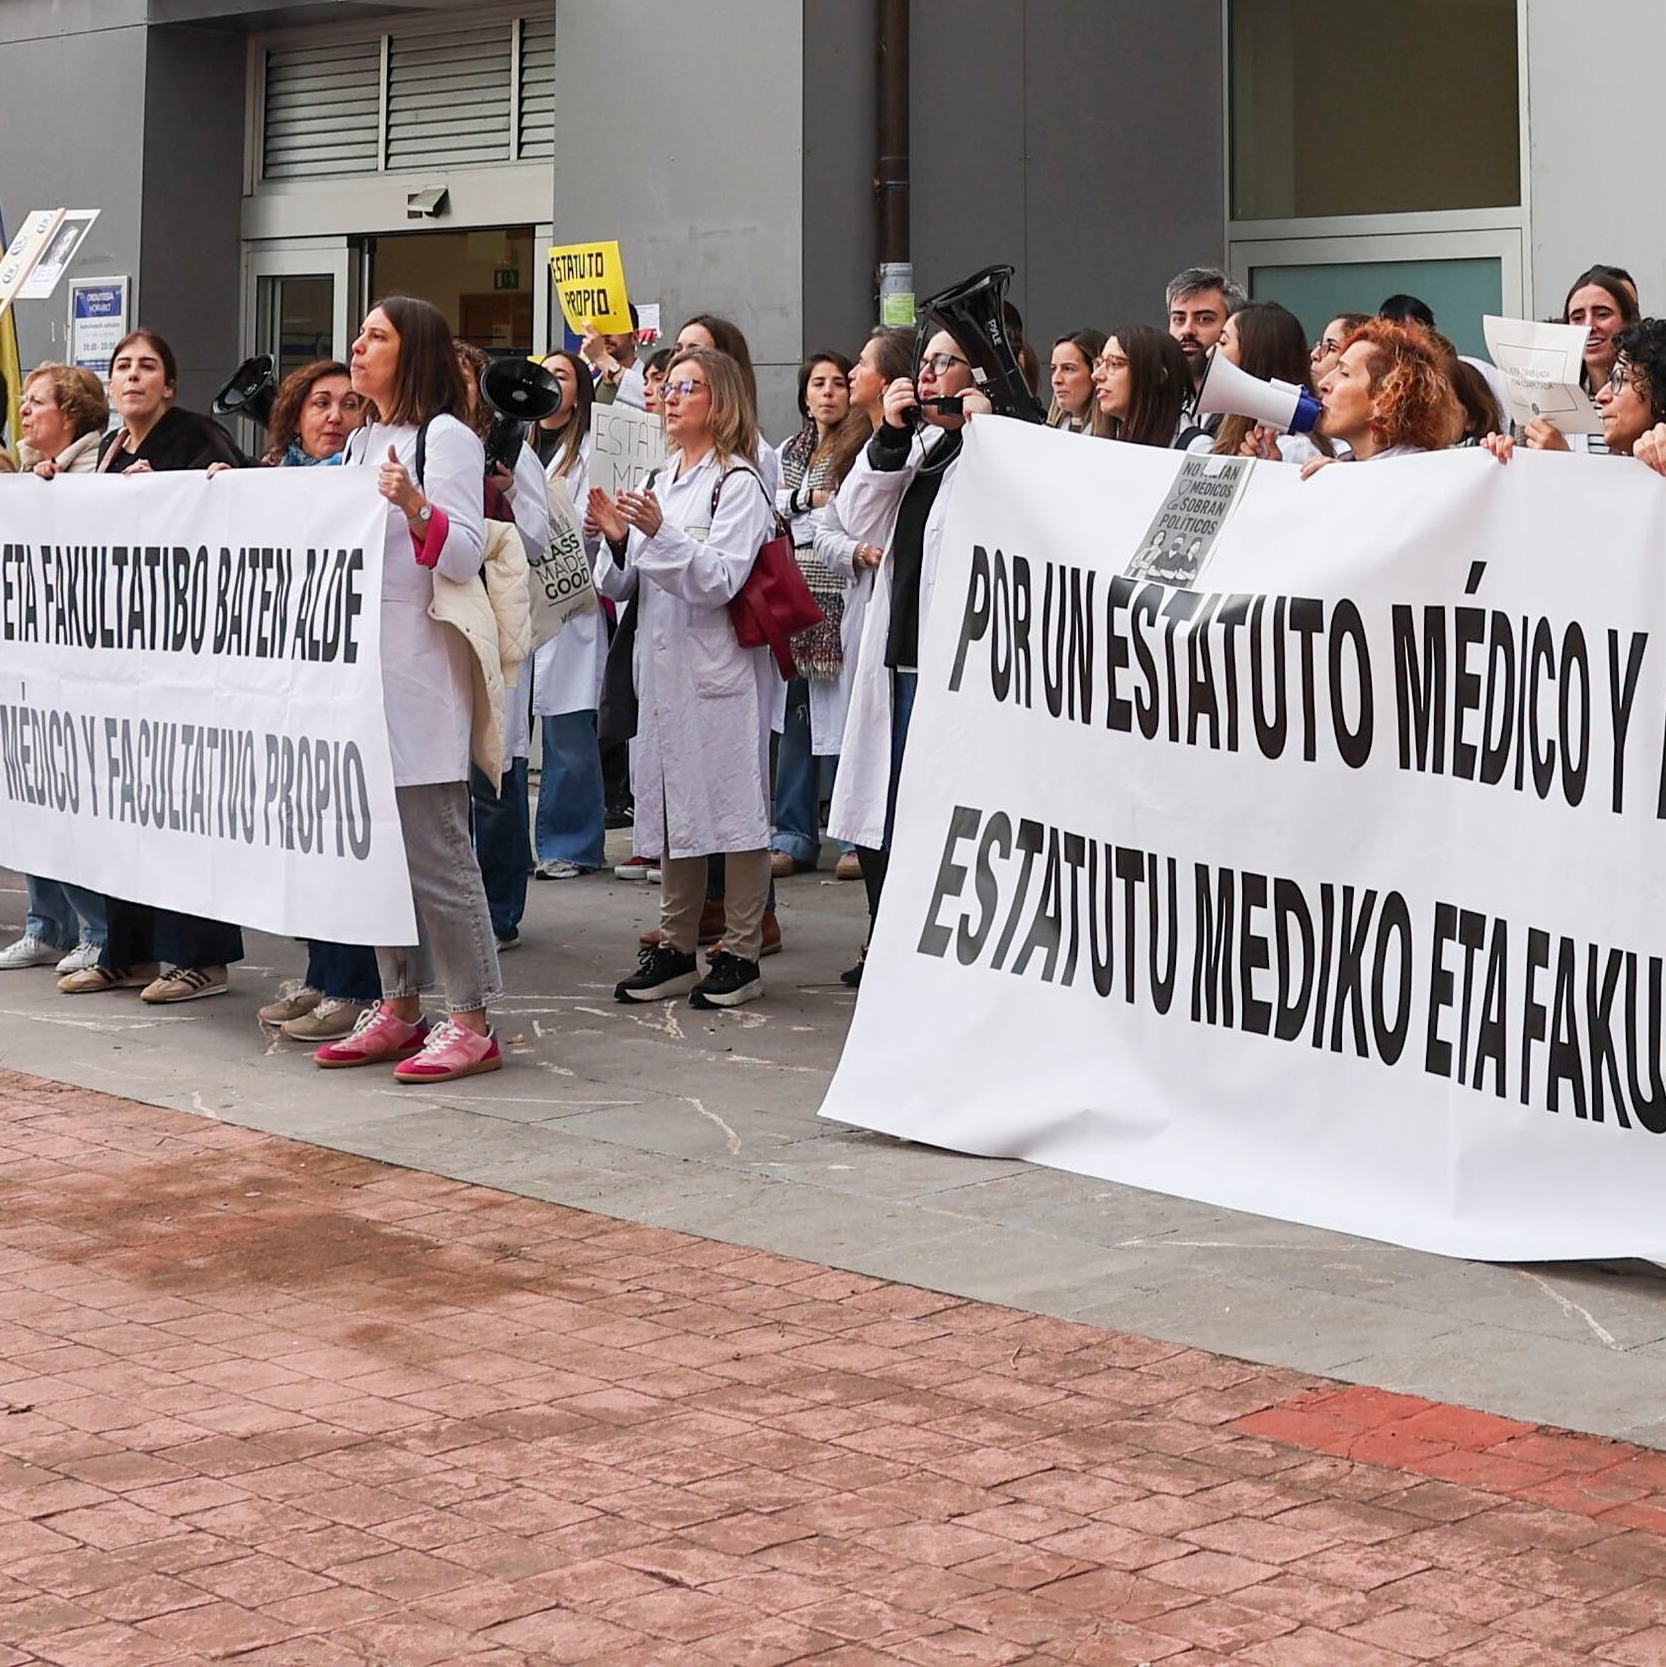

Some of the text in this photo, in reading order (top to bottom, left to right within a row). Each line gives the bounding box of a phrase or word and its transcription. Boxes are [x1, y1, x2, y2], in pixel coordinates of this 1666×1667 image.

[550, 252, 604, 283] ESTATUTO
[565, 289, 617, 317] PROPIO.
[988, 318, 1002, 346] PYLE
[596, 413, 663, 458] ESTAT
[1183, 462, 1199, 476] NO
[1190, 479, 1234, 498] MÉDICOS
[1180, 497, 1226, 516] SOBRAN
[1159, 514, 1218, 535] POLÍTICOS
[535, 549, 585, 585] MADE
[545, 567, 590, 599] GOOD
[3, 543, 38, 644] ETA
[40, 545, 208, 655] FAKULTATIBO
[213, 547, 292, 660] BATEN
[291, 548, 364, 664] ALDE
[949, 544, 1032, 709] POR
[1042, 562, 1095, 725] UN
[1106, 574, 1375, 770] ESTATUTO
[1392, 560, 1593, 809] MÉDICO
[1605, 628, 1649, 814] Y
[0, 681, 80, 815] MÉDICO
[81, 714, 98, 817] Y
[104, 717, 256, 845] FACULTATIVO
[265, 734, 371, 861] PROPIO
[916, 804, 1178, 1017] ESTATUTU
[1190, 861, 1413, 1067] MEDIKO
[1425, 901, 1508, 1100] ETA
